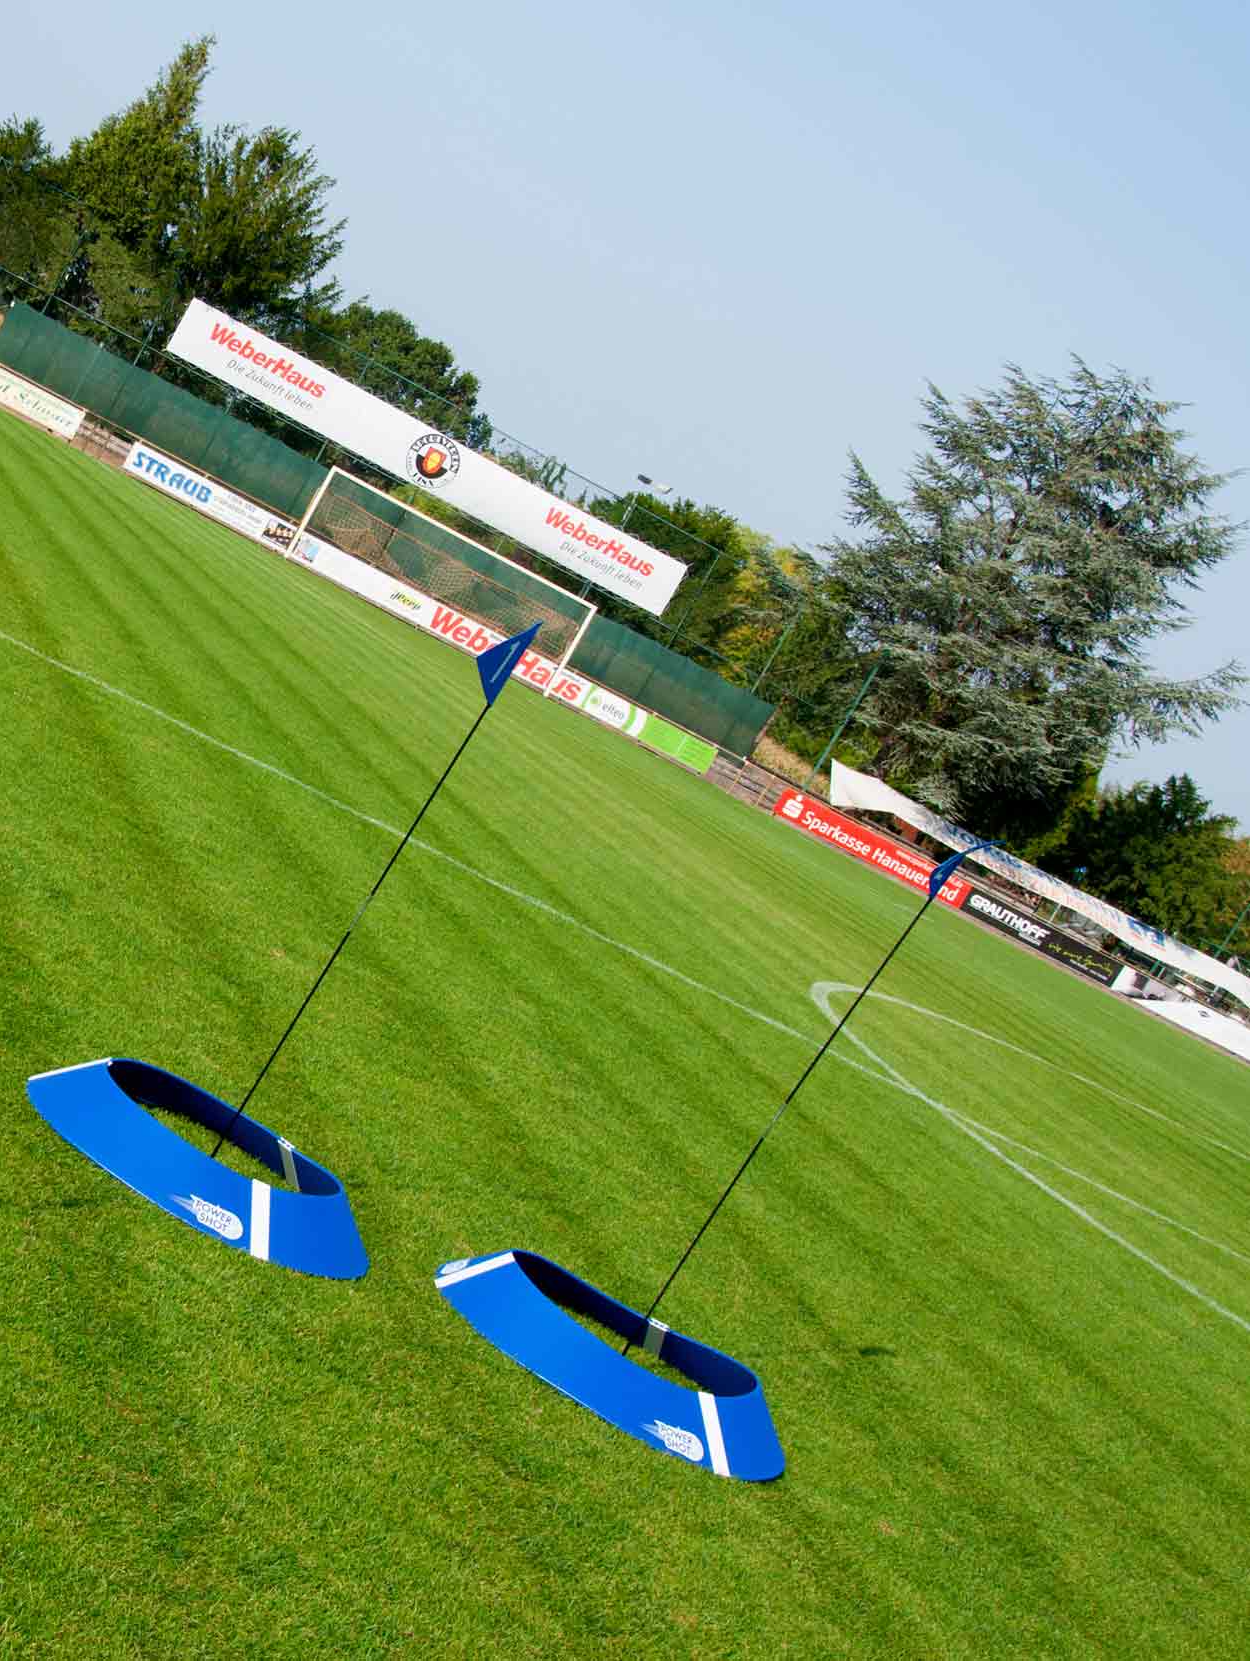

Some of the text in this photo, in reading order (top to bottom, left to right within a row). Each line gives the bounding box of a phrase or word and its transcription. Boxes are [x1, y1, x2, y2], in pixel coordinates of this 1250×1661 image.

[210, 323, 327, 399] WeberHaus
[133, 451, 213, 504] STRAUB
[545, 507, 655, 577] WeberHaus
[430, 606, 582, 701] WebHaus
[801, 810, 871, 855] Sparkasse
[871, 847, 959, 902] Hanauernd
[970, 894, 1052, 941] GRAUTHOFF
[195, 1200, 232, 1225] POWER
[199, 1211, 229, 1233] SHOT
